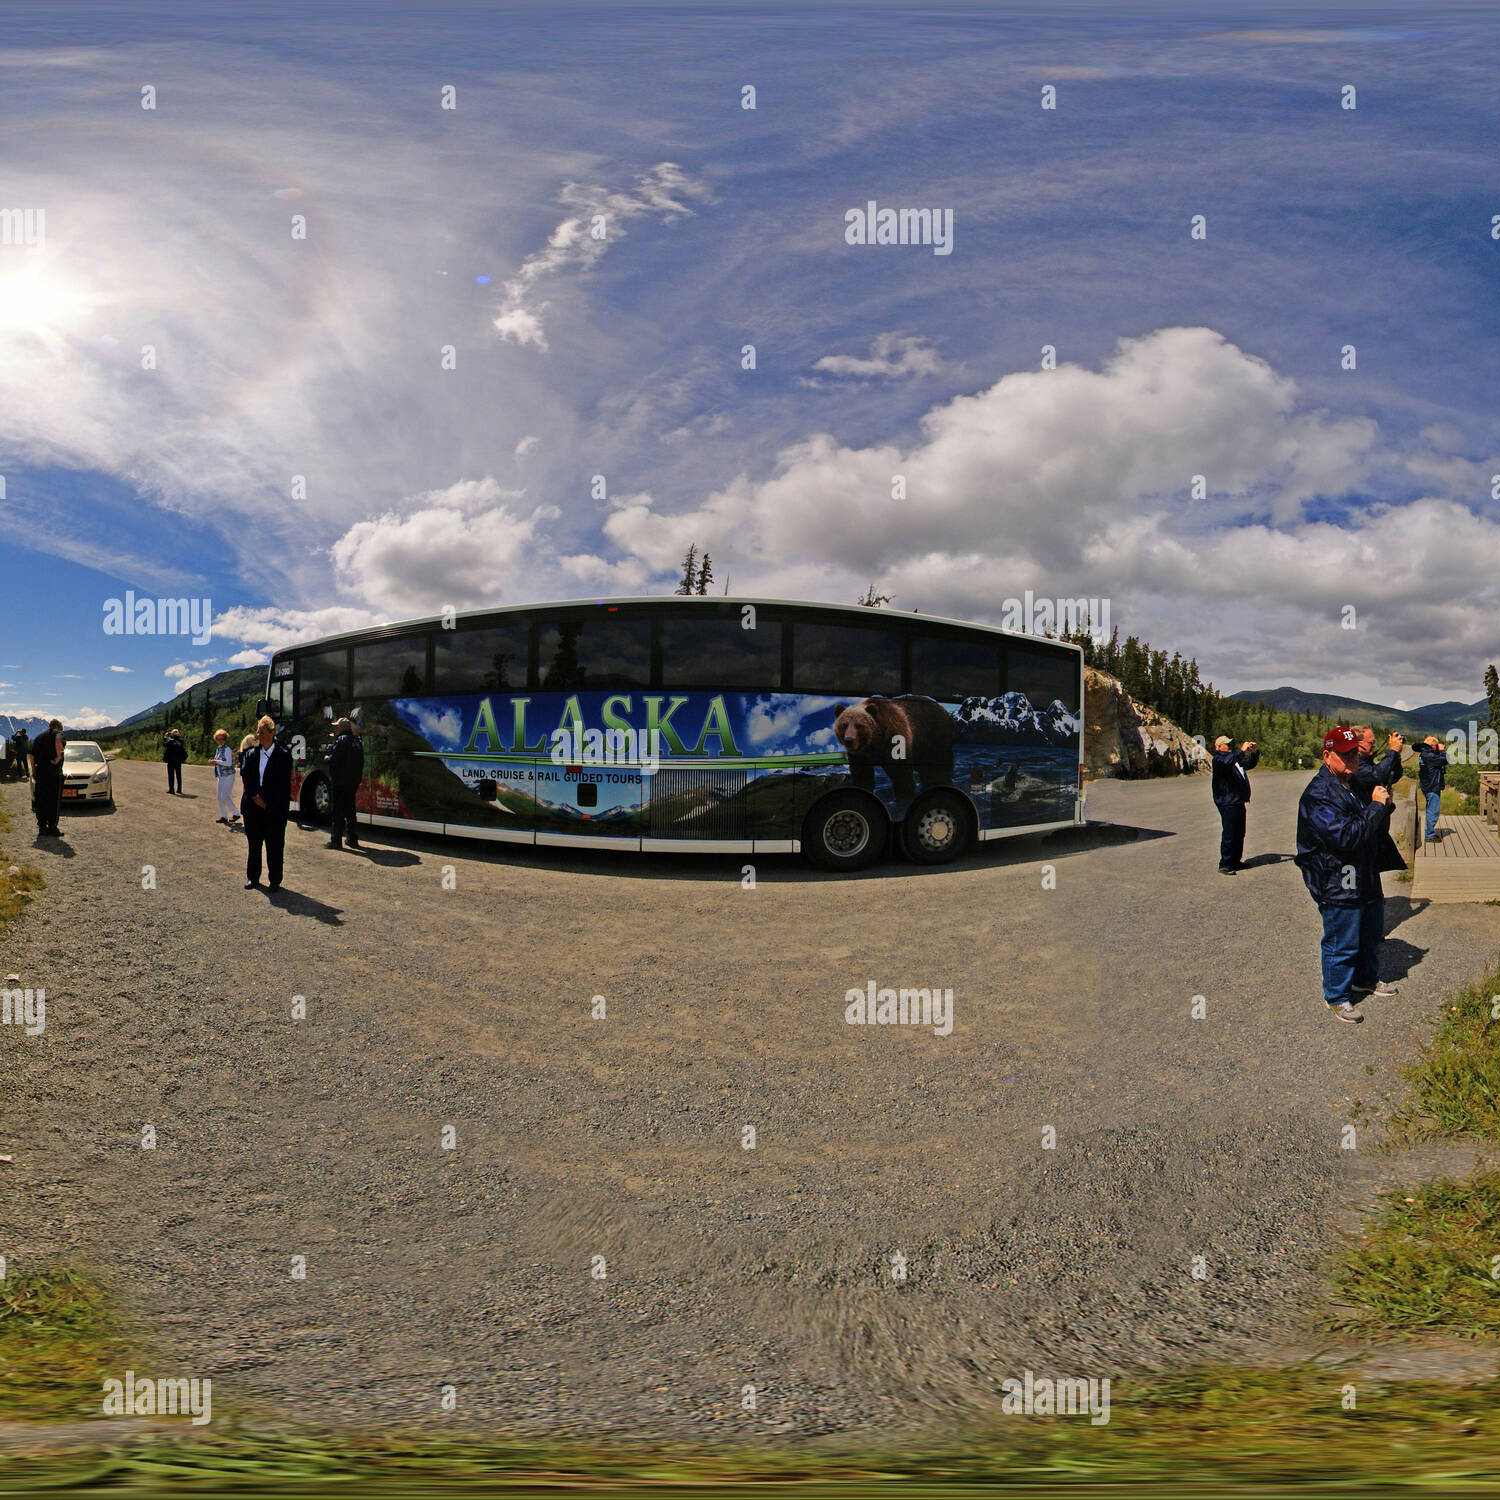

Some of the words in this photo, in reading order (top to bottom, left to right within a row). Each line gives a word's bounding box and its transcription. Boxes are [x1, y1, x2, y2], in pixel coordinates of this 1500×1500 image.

[463, 694, 744, 757] ALASKA
[462, 768, 488, 780] LAND,
[490, 769, 524, 781] CRUISE
[527, 771, 534, 781] &
[537, 771, 561, 782] RAIL
[563, 772, 603, 784] GUIDED
[606, 773, 643, 785] TOURS
